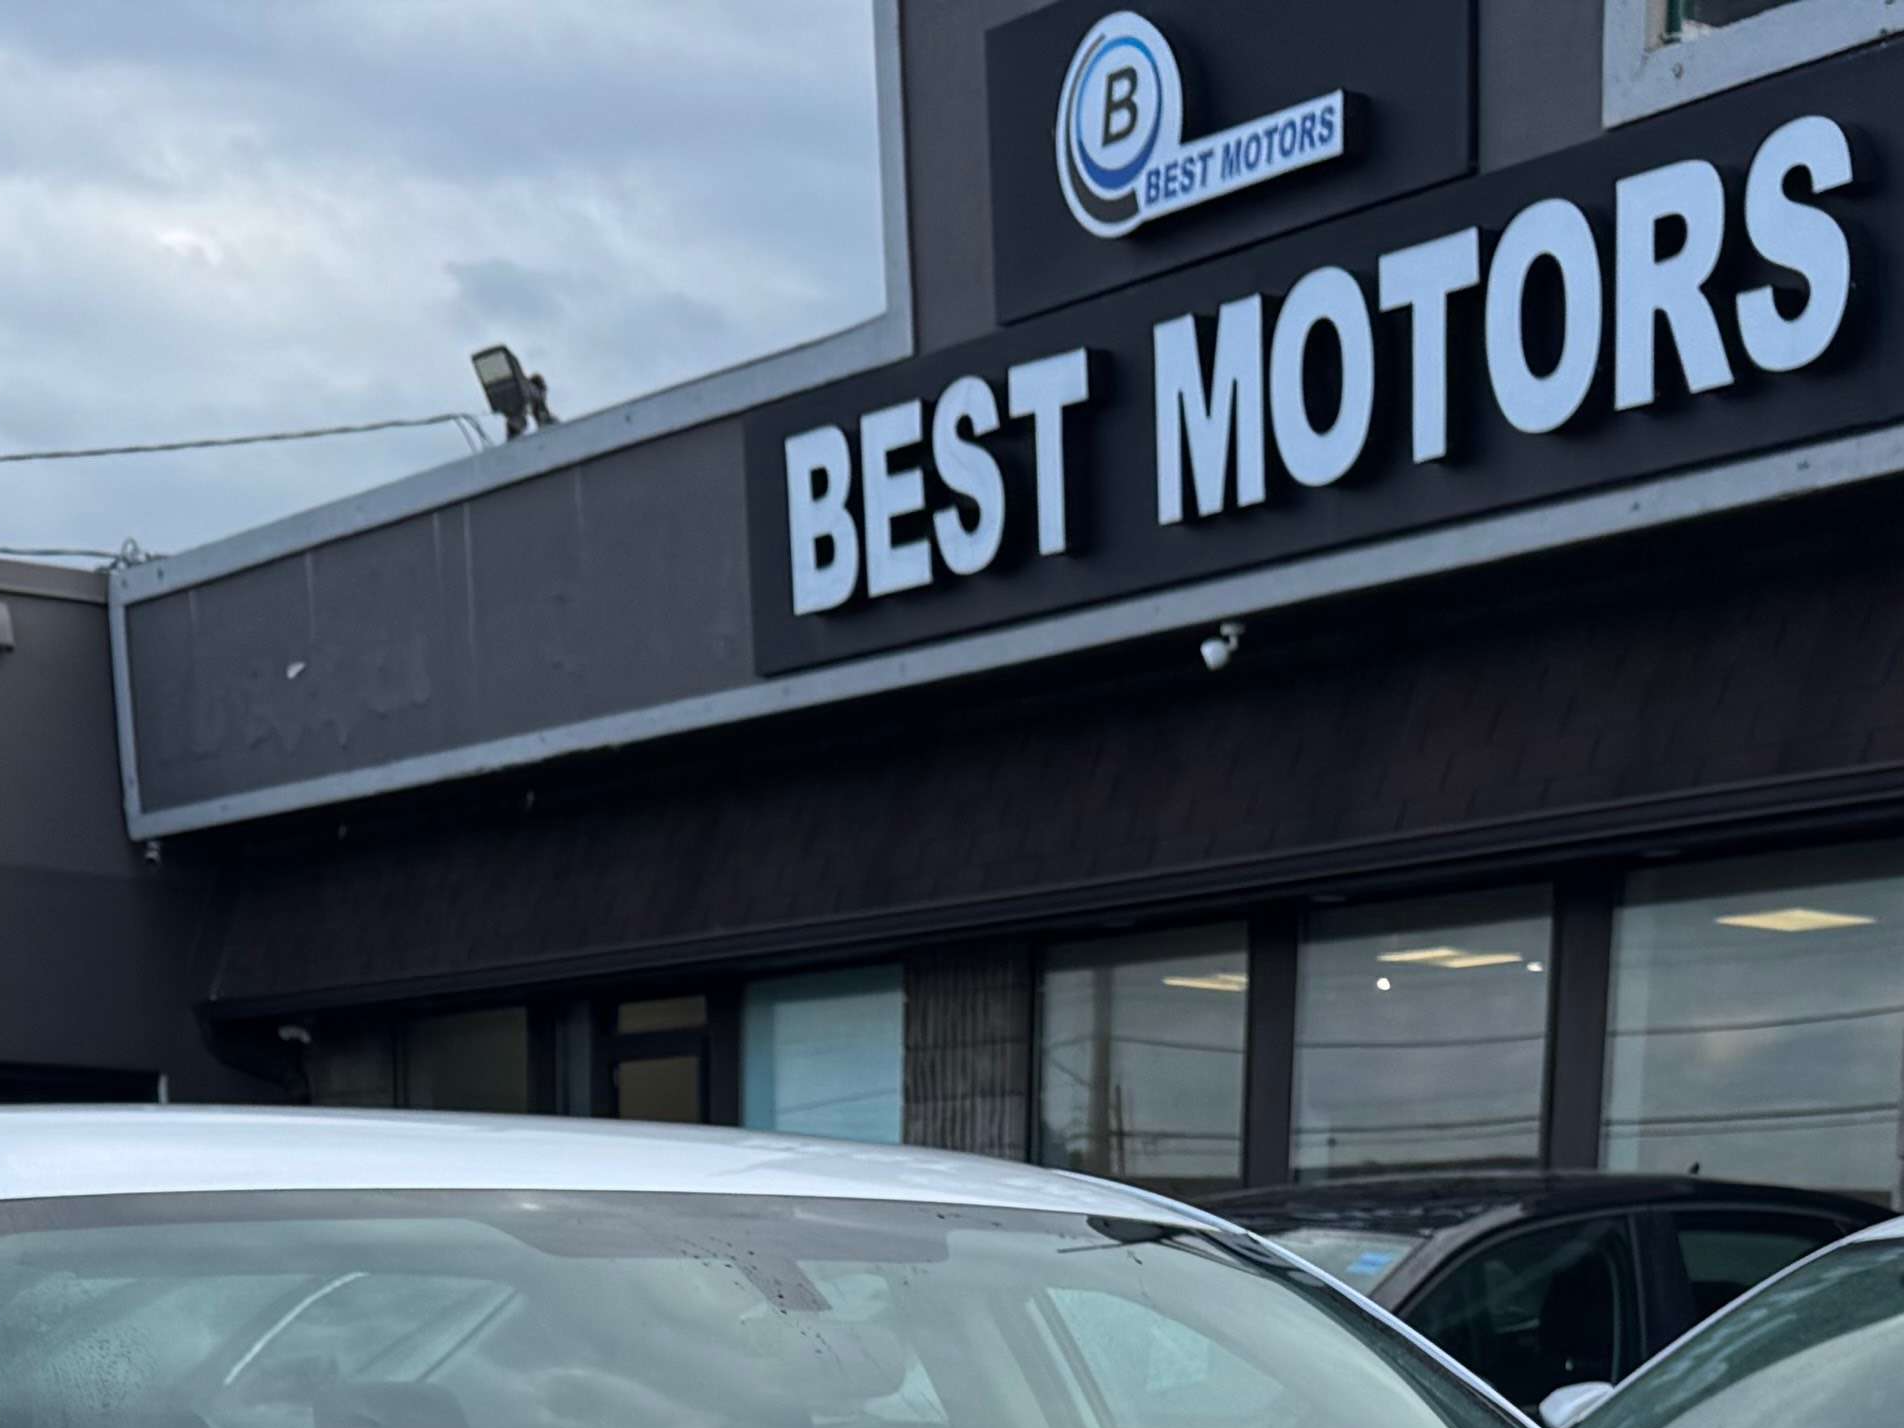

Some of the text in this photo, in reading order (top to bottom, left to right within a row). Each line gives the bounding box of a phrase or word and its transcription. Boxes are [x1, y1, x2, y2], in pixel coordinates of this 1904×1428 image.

[1102, 66, 1137, 148] B
[1145, 106, 1335, 208] BEST MOTORS
[784, 115, 1855, 616] BEST MOTORS
